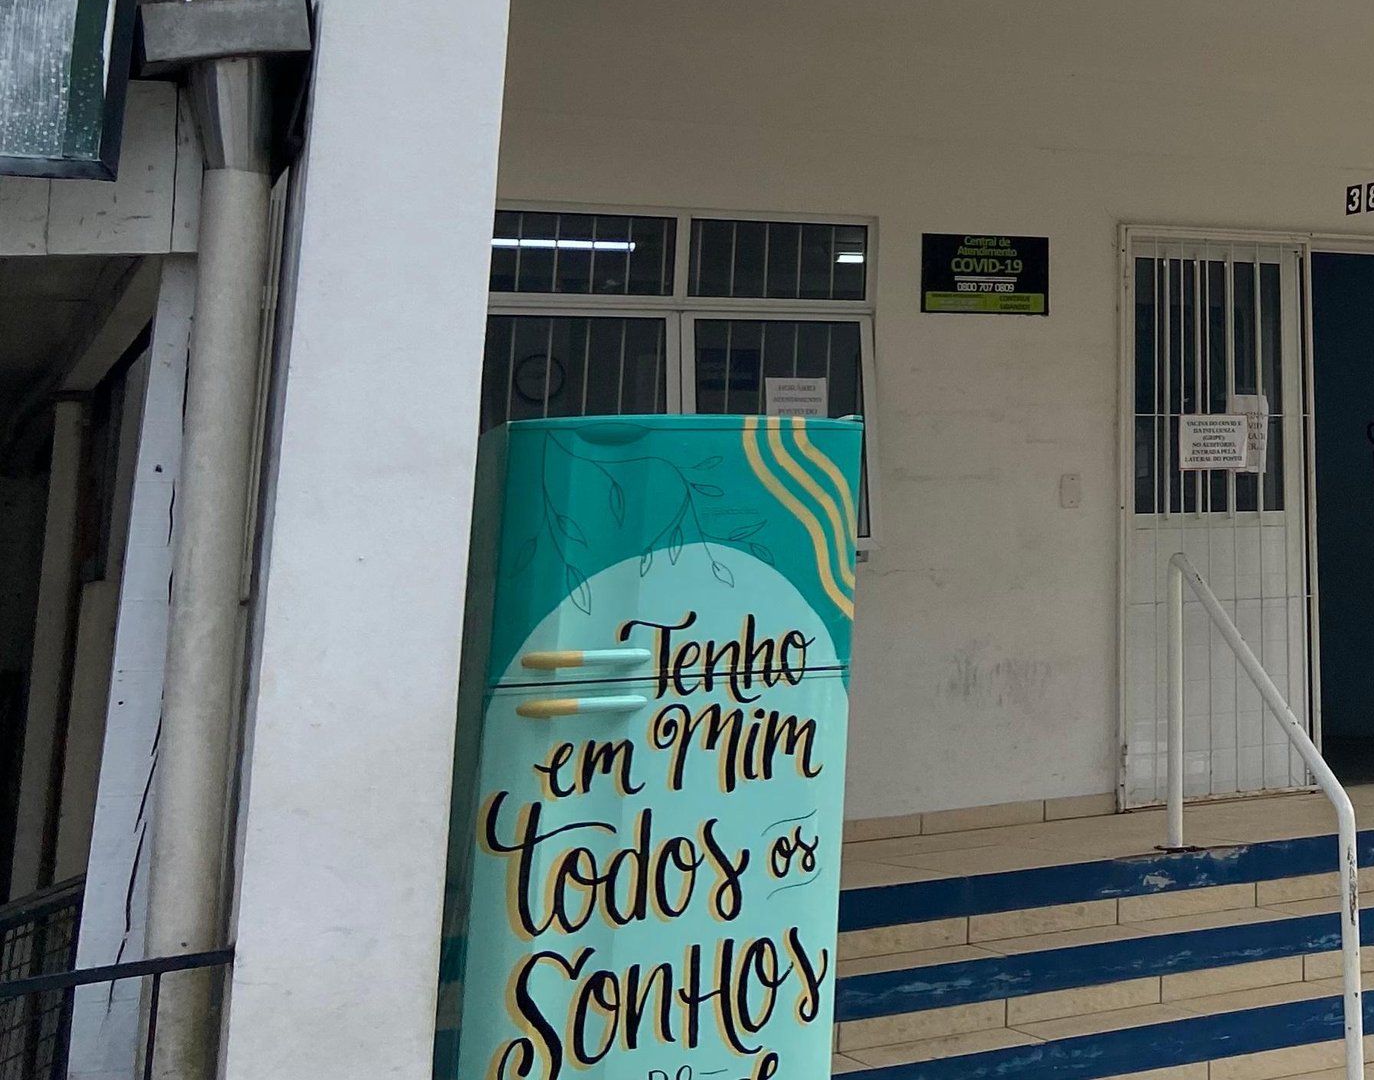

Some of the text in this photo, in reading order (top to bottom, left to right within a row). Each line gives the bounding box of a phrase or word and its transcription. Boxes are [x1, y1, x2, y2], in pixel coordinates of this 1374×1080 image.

[964, 236, 1011, 247] Central de
[957, 246, 1017, 257] Atendimento
[951, 257, 1023, 274] COVID-19
[979, 283, 993, 292] 707
[619, 611, 816, 703] Tenho
[534, 703, 823, 798] em Mim
[771, 825, 819, 879] os
